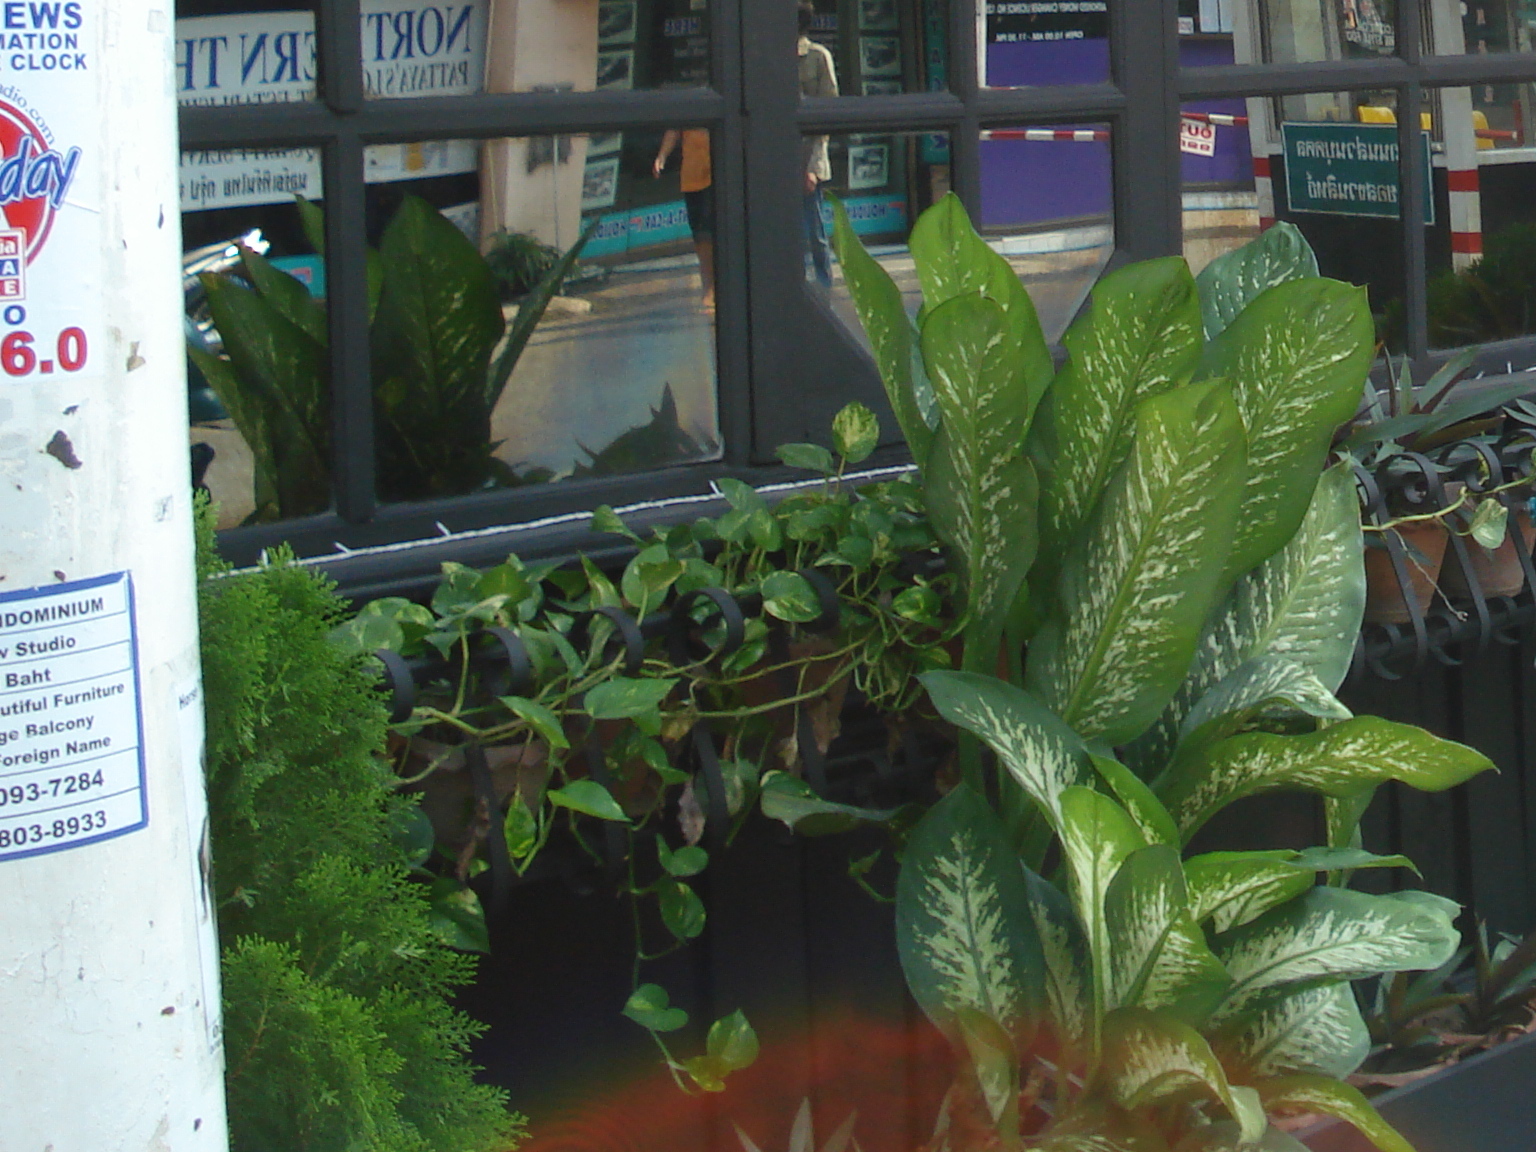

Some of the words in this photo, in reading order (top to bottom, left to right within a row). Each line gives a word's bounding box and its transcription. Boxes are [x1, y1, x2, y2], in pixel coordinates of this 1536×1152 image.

[4, 1, 83, 30] EWS
[10, 53, 88, 71] CLOCK
[0, 598, 105, 628] DOMINIUM
[16, 635, 77, 658] Studio
[5, 668, 52, 689] Baht
[53, 682, 125, 708] Furniture
[26, 714, 95, 739] Balcony
[66, 734, 112, 756] Name
